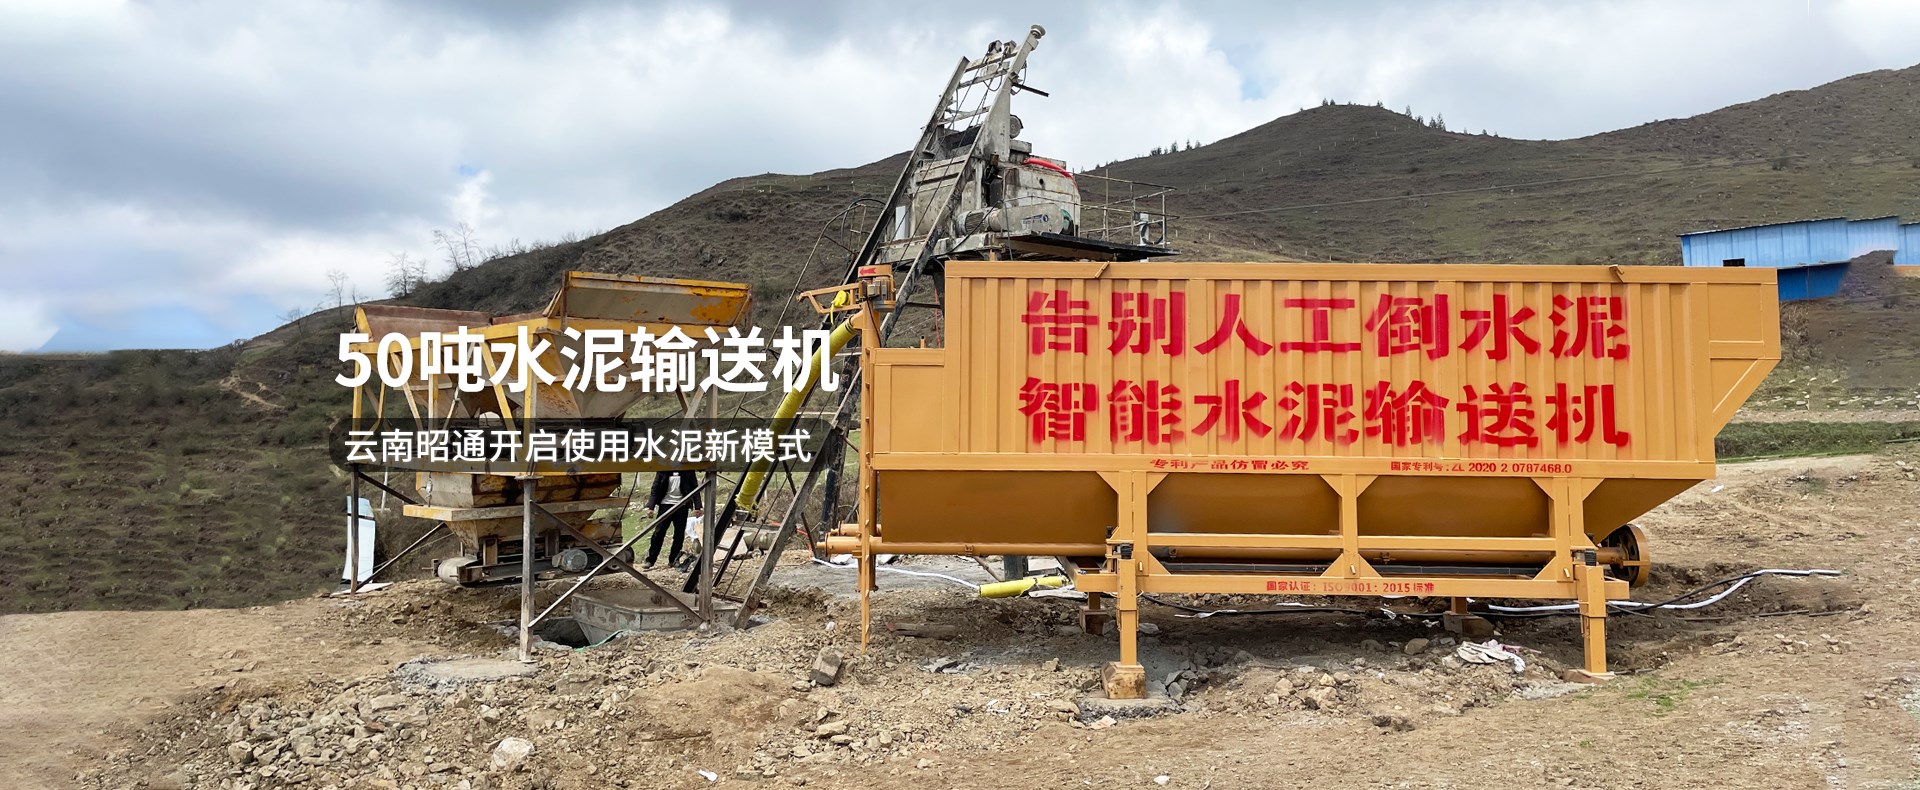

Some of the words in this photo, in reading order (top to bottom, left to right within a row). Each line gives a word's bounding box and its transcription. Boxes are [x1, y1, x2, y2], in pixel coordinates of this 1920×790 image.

[1021, 290, 1631, 361] 告别人工倒水泥
[1018, 376, 1631, 448] 智能水泥输送机
[1469, 462, 1497, 473] 2020
[1501, 463, 1508, 473] 2
[1512, 463, 1572, 474] 0787468.0
